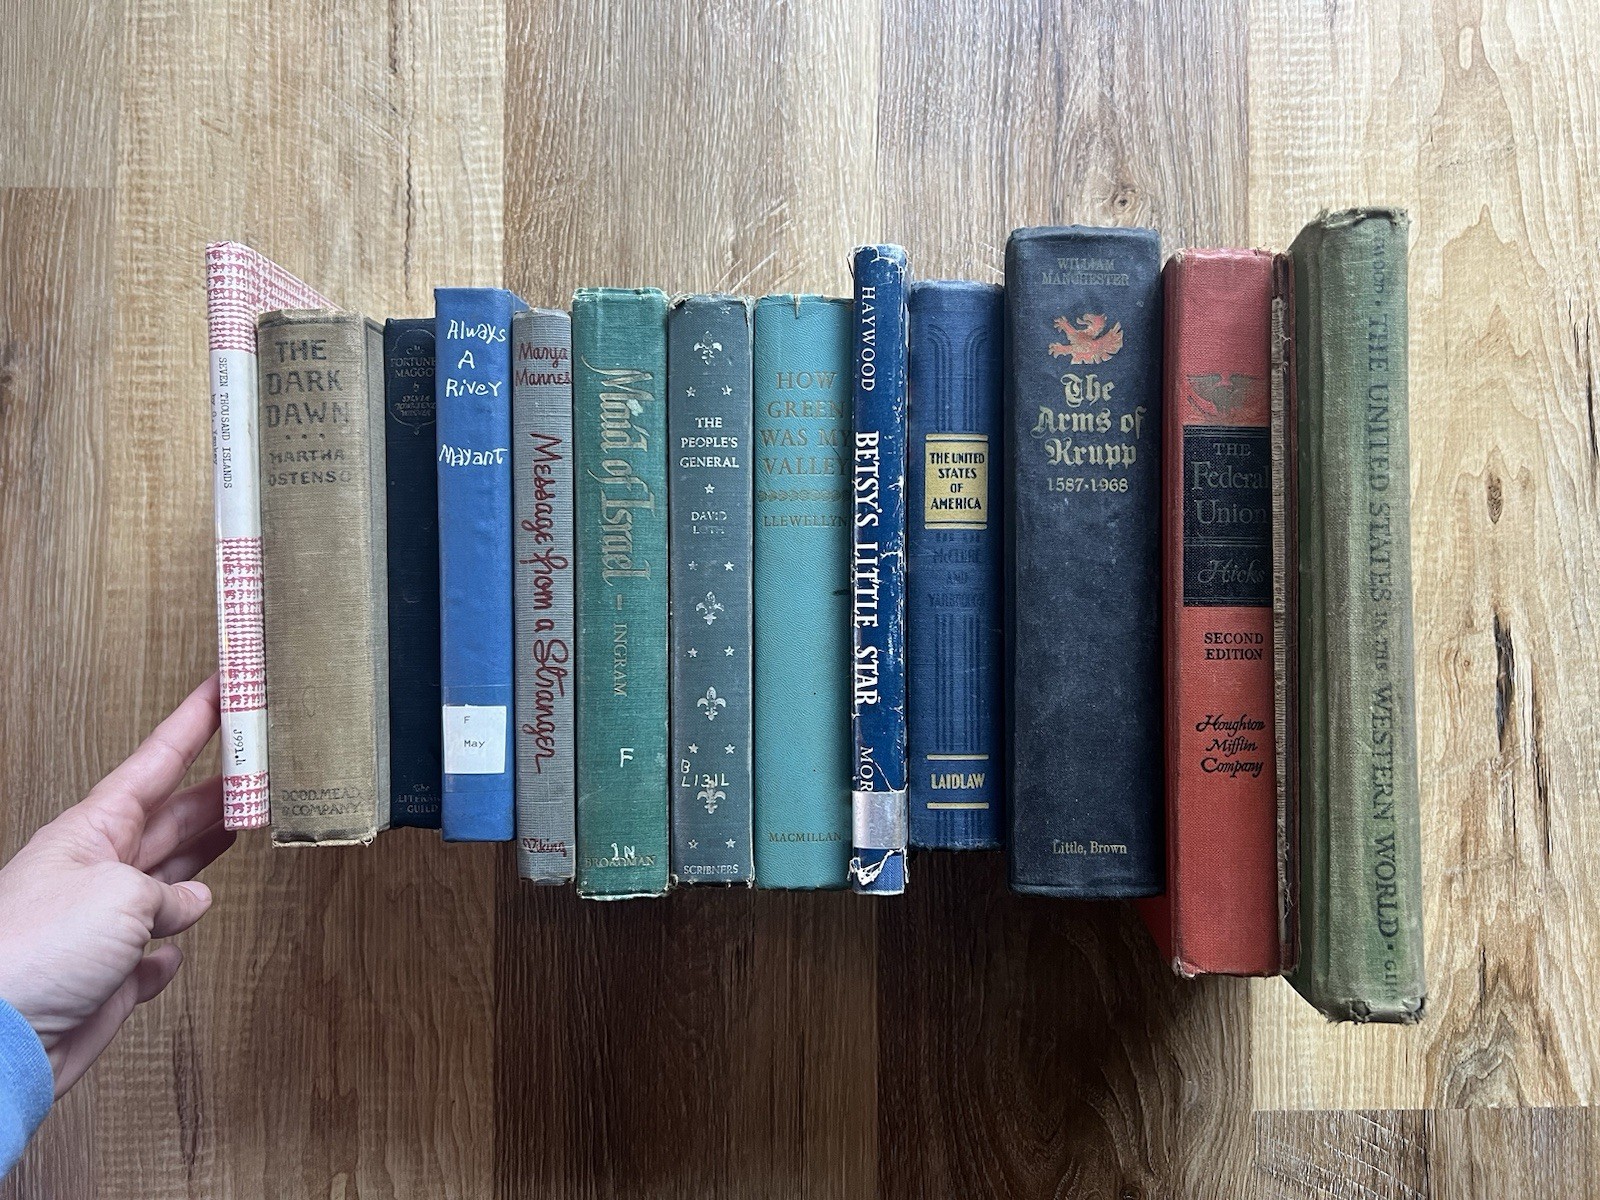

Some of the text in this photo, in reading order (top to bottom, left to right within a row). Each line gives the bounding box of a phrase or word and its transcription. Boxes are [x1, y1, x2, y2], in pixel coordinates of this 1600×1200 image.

[1056, 257, 1115, 272] WILLIAM
[1041, 272, 1130, 287] MANCHESTER
[446, 319, 507, 344] Always
[860, 286, 876, 392] HAYWOOD
[275, 339, 327, 363] THE
[1368, 312, 1389, 372] THE
[457, 350, 475, 370] A
[265, 369, 343, 396] DARK
[394, 368, 435, 378] MAGGO
[775, 371, 838, 390] HOW
[445, 378, 502, 397] River
[1060, 373, 1115, 408] The
[265, 401, 350, 428] DAWN
[767, 400, 846, 419] GREEN
[218, 357, 232, 489] SEVEN THOUSAND ISLANDS
[694, 416, 723, 428] THE
[1030, 405, 1148, 440] Arms of
[680, 436, 739, 449] PEOPLE'S
[758, 428, 850, 448] WAS MY
[1367, 383, 1391, 492] UNITED
[269, 448, 345, 464] MARTHA
[929, 452, 985, 464] THE UNITED
[1044, 437, 1137, 470] Krupp
[1212, 442, 1251, 457] THE
[679, 456, 740, 468] GENERAL
[762, 457, 849, 476] VALLEY
[268, 470, 351, 487] OSTENSO
[938, 467, 978, 479] STATES
[1190, 461, 1270, 490] Federal
[949, 483, 964, 494] OF
[930, 497, 982, 510] AMERICA
[1194, 499, 1269, 524] Union
[690, 510, 728, 521] DAVID
[763, 515, 848, 528] LLEWELLYN
[581, 354, 657, 697] Maid of Israel INGRAM
[1368, 501, 1392, 602] STATES
[853, 430, 883, 707] BETSY'S LITTLE STAR
[1197, 558, 1266, 584] Hicks
[519, 432, 569, 775] Message from a Stranger
[1203, 632, 1264, 645] SECOND
[1204, 648, 1264, 660] EDITION
[463, 715, 471, 724] F
[1195, 714, 1266, 737] Houghton
[463, 740, 486, 748] May
[1205, 736, 1258, 757] Mifflin
[1371, 680, 1395, 822] WESTERN
[619, 747, 635, 768] F
[680, 758, 691, 774] B
[1200, 757, 1264, 778] Company
[930, 773, 986, 790] LAIDLAW
[406, 804, 439, 813] GUILD
[768, 832, 842, 843] MACMILLAN
[521, 837, 568, 858] Viking
[1052, 840, 1128, 855] Little, Brown
[584, 855, 656, 869] BROADMAN
[683, 863, 739, 875] SCRIBNERS
[1374, 831, 1399, 938] WORLD
